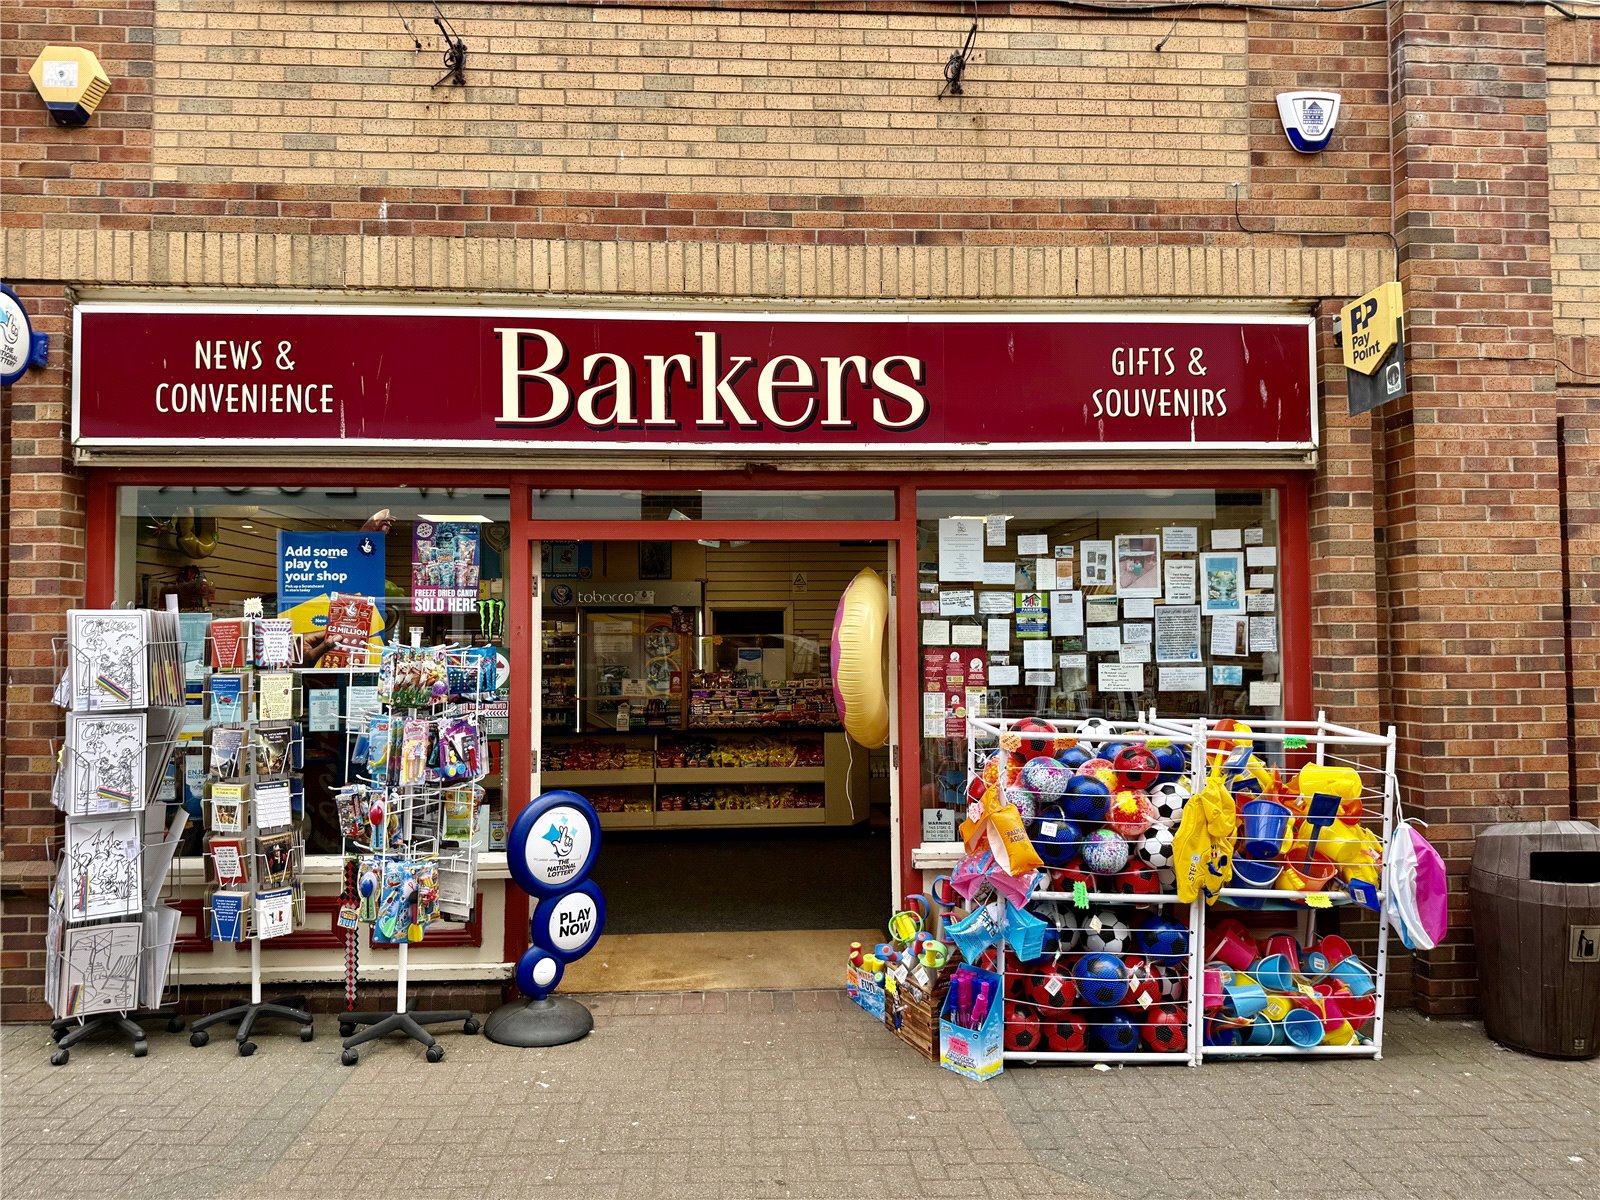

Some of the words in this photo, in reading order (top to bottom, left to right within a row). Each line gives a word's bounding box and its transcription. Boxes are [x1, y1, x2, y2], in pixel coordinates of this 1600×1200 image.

[1352, 332, 1370, 350] Pay
[4, 345, 14, 353] THE
[195, 340, 262, 370] NEWS
[276, 340, 296, 371] &
[1353, 340, 1380, 364] Point
[0, 352, 18, 362] TIONAL
[0, 358, 16, 367] TTERY
[1111, 347, 1175, 376] GIFTS
[1188, 347, 1207, 376] &
[493, 327, 928, 429] Barkers
[155, 383, 334, 413] CONVENIENCE
[1092, 388, 1227, 417] SOUVENIRS
[285, 546, 311, 556] Add
[313, 548, 348, 557] some
[285, 558, 312, 571] play
[314, 559, 328, 569] to
[285, 573, 314, 583] your
[316, 571, 348, 583] shop
[415, 589, 436, 597] FREEZE
[438, 589, 455, 597] DRIED
[457, 589, 477, 597] CANDY
[578, 590, 634, 603] tobacco
[415, 598, 444, 612] SOLD
[448, 598, 477, 612] HERE
[337, 627, 368, 636] MILLION
[546, 863, 576, 873] NATIONAL
[547, 868, 574, 877] LOTTERY
[560, 907, 591, 925] PLAY
[559, 920, 591, 937] NOW
